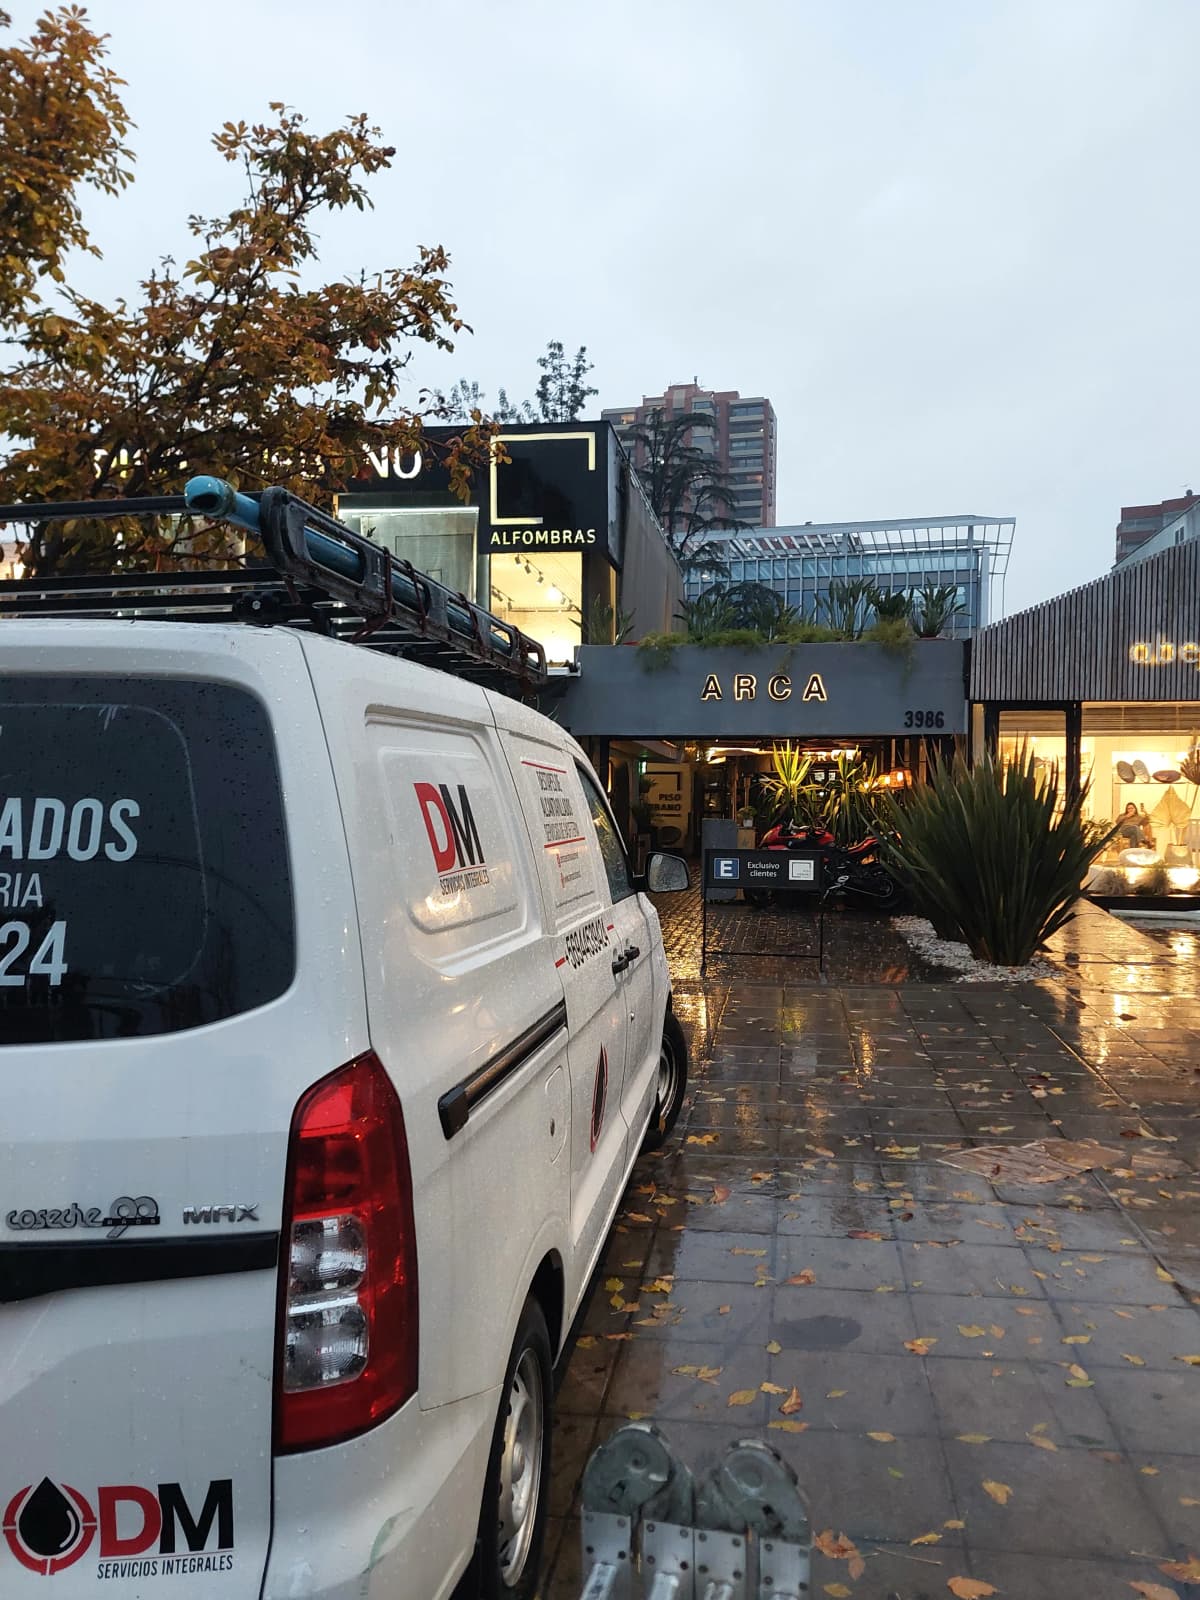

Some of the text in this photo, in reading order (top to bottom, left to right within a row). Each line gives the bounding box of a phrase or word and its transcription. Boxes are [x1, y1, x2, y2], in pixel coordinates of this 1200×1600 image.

[490, 528, 596, 545] ALFOMBRAS
[701, 674, 828, 702] ARCA
[904, 710, 945, 729] 3986
[658, 793, 681, 801] PISO
[0, 797, 141, 862] ADOS
[413, 782, 486, 873] DM
[720, 860, 733, 877] E
[747, 861, 780, 870] Exclusivo
[750, 869, 777, 878] clientes
[0, 872, 44, 908] RIA
[0, 920, 69, 986] 24
[183, 1203, 260, 1225] MAX
[97, 1478, 235, 1558] DM
[96, 1554, 234, 1580] SERVICIOS INTEGRALES
